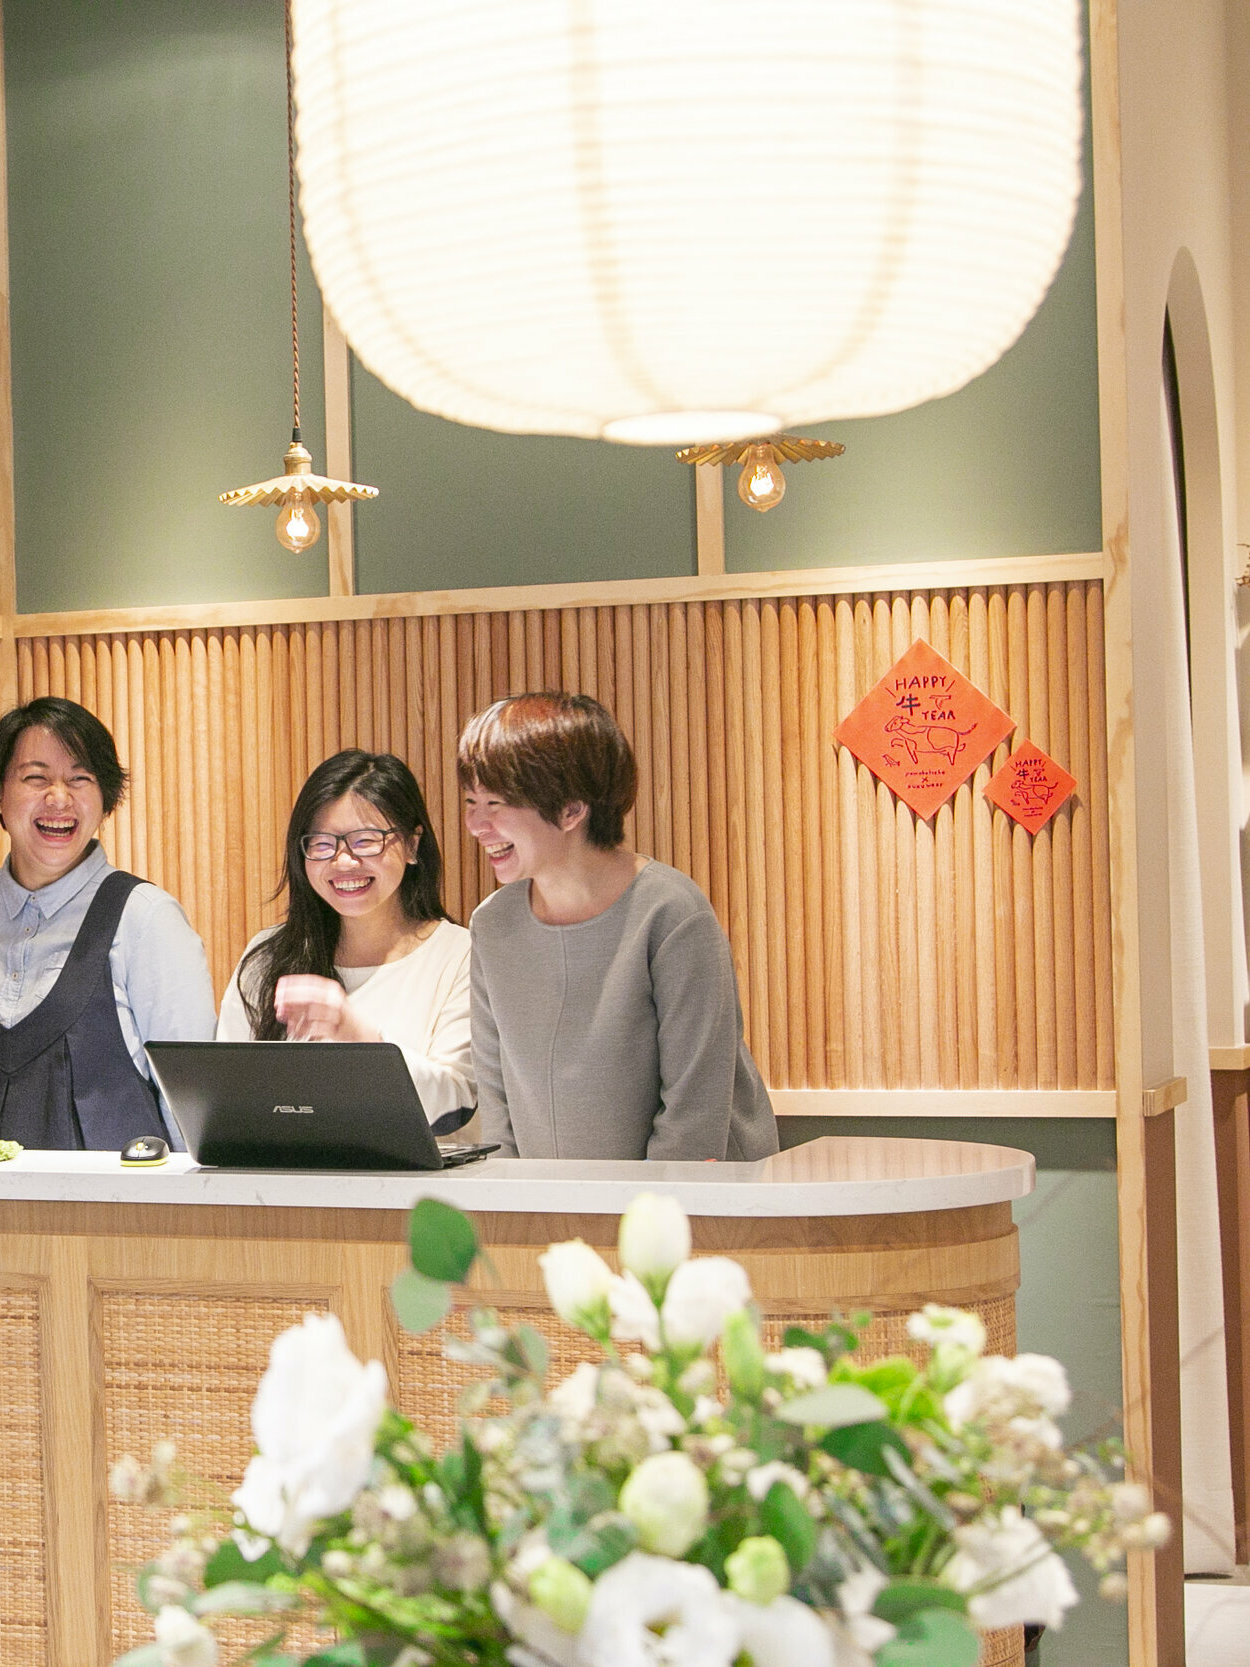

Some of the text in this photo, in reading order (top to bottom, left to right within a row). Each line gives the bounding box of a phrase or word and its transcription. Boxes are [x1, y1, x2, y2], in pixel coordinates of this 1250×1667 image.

[895, 675, 947, 691] HAPPY
[895, 693, 921, 716] 牛
[921, 709, 956, 721] YEAR
[1015, 758, 1042, 768] HAPPY
[272, 1105, 314, 1114] ASUS
